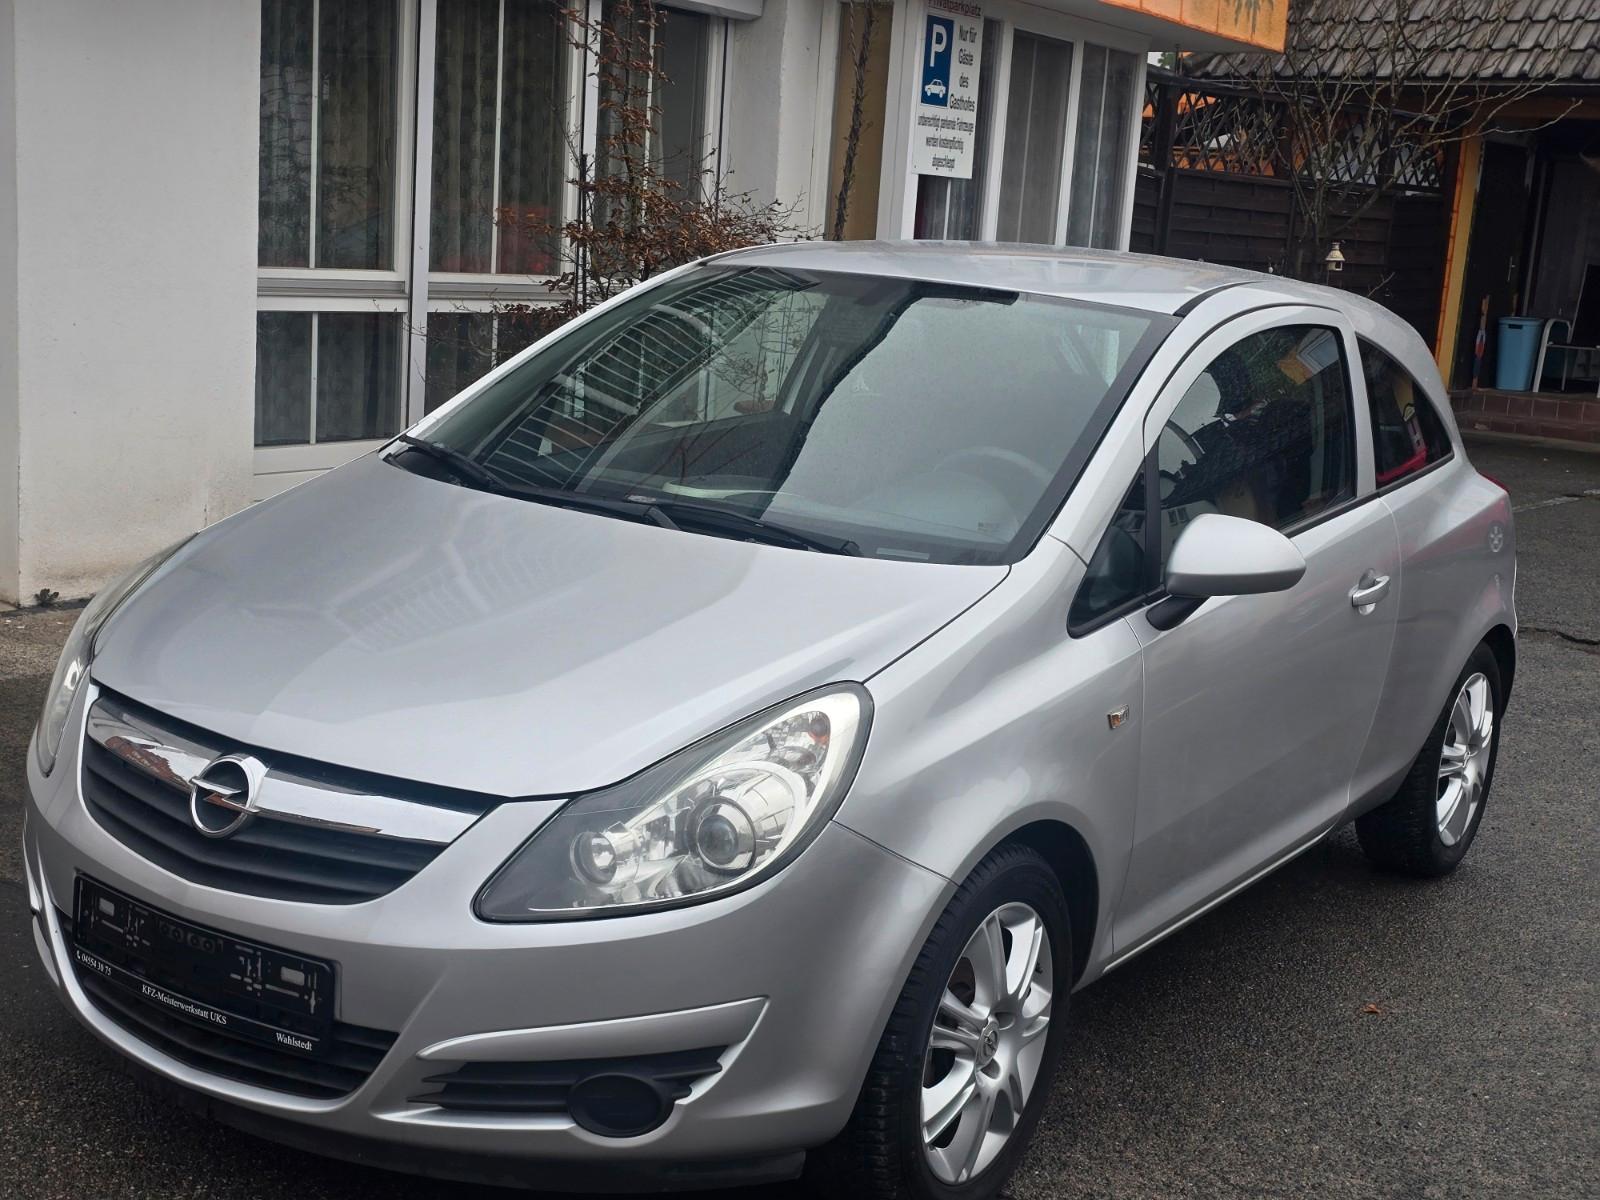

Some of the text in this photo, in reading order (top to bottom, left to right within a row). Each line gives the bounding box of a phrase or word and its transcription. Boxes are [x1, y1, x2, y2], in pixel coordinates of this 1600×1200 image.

[959, 25, 969, 41] Nur
[930, 24, 947, 67] P
[959, 73, 969, 88] des
[142, 984, 227, 1025] KFZ-Meisterwerkstatt UKS
[276, 1032, 313, 1051] Wahlstedt
